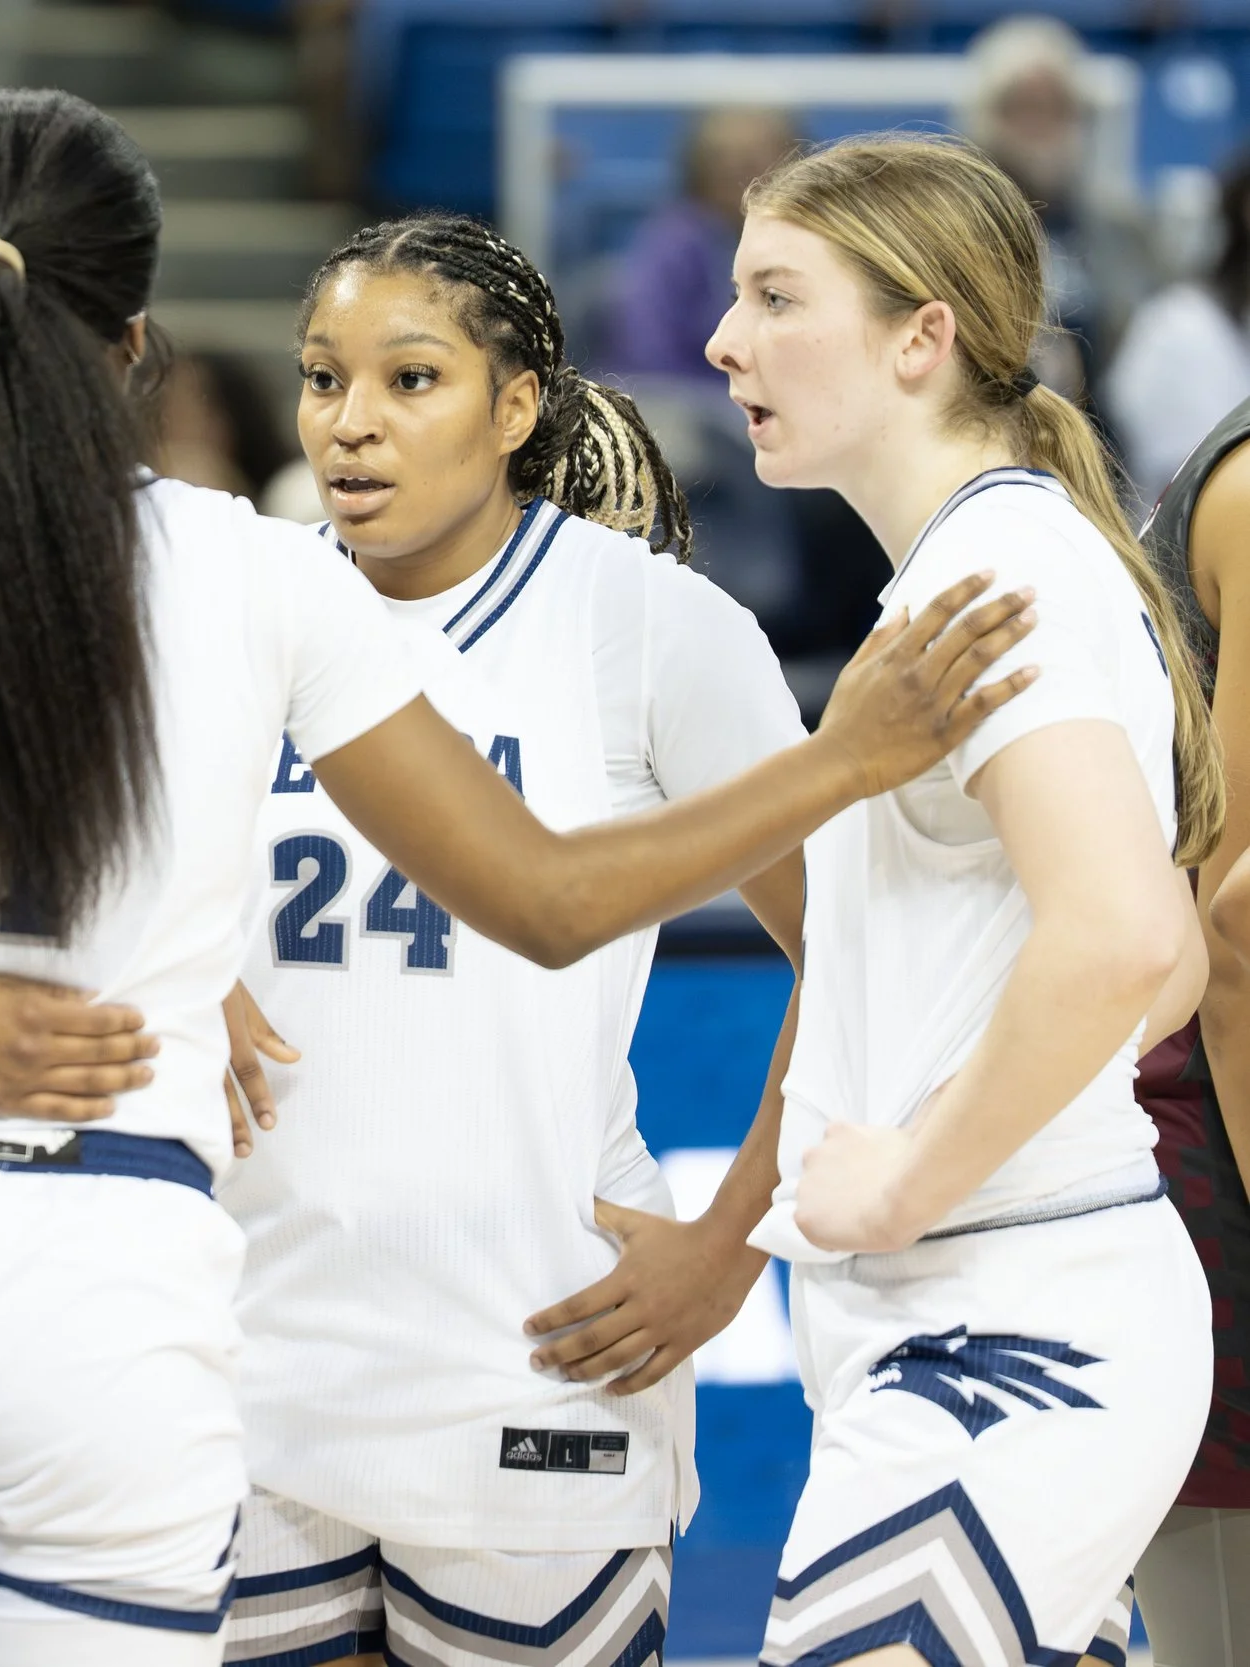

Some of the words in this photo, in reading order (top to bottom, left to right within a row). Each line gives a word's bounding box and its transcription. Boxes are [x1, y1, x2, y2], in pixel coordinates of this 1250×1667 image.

[268, 828, 458, 977] 24
[506, 1451, 543, 1462] adidas
[565, 1448, 572, 1462] L
